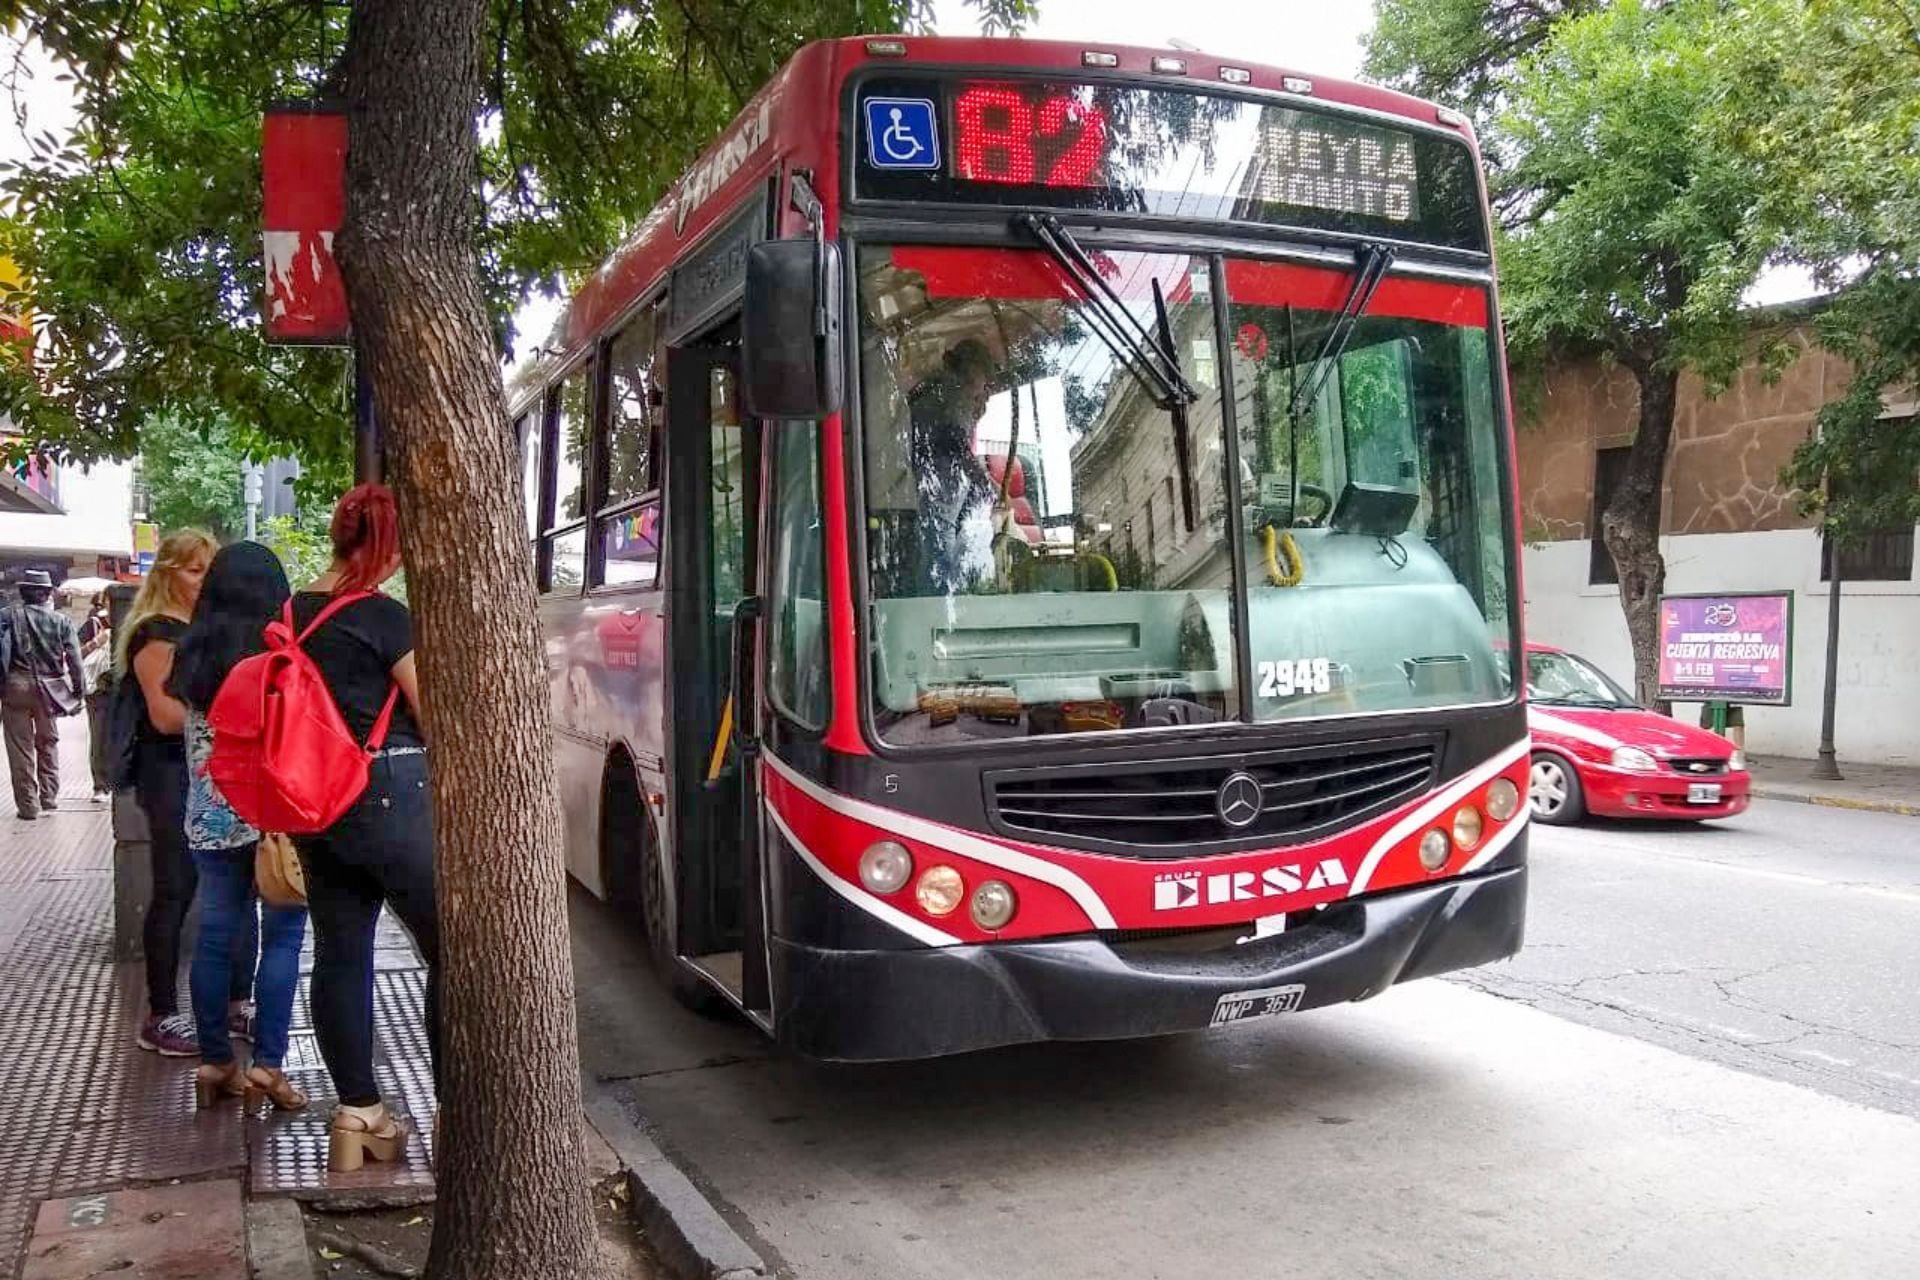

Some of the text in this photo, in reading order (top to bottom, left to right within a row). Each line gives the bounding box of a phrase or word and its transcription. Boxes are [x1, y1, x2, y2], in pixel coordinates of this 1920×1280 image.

[957, 88, 1104, 187] 82
[1666, 643, 1780, 660] CUENTA REGRESIVA
[1257, 657, 1330, 697] 2948
[1695, 663, 1714, 676] FEB
[1154, 871, 1202, 882] GRUPO
[1261, 993, 1295, 1015] 361
